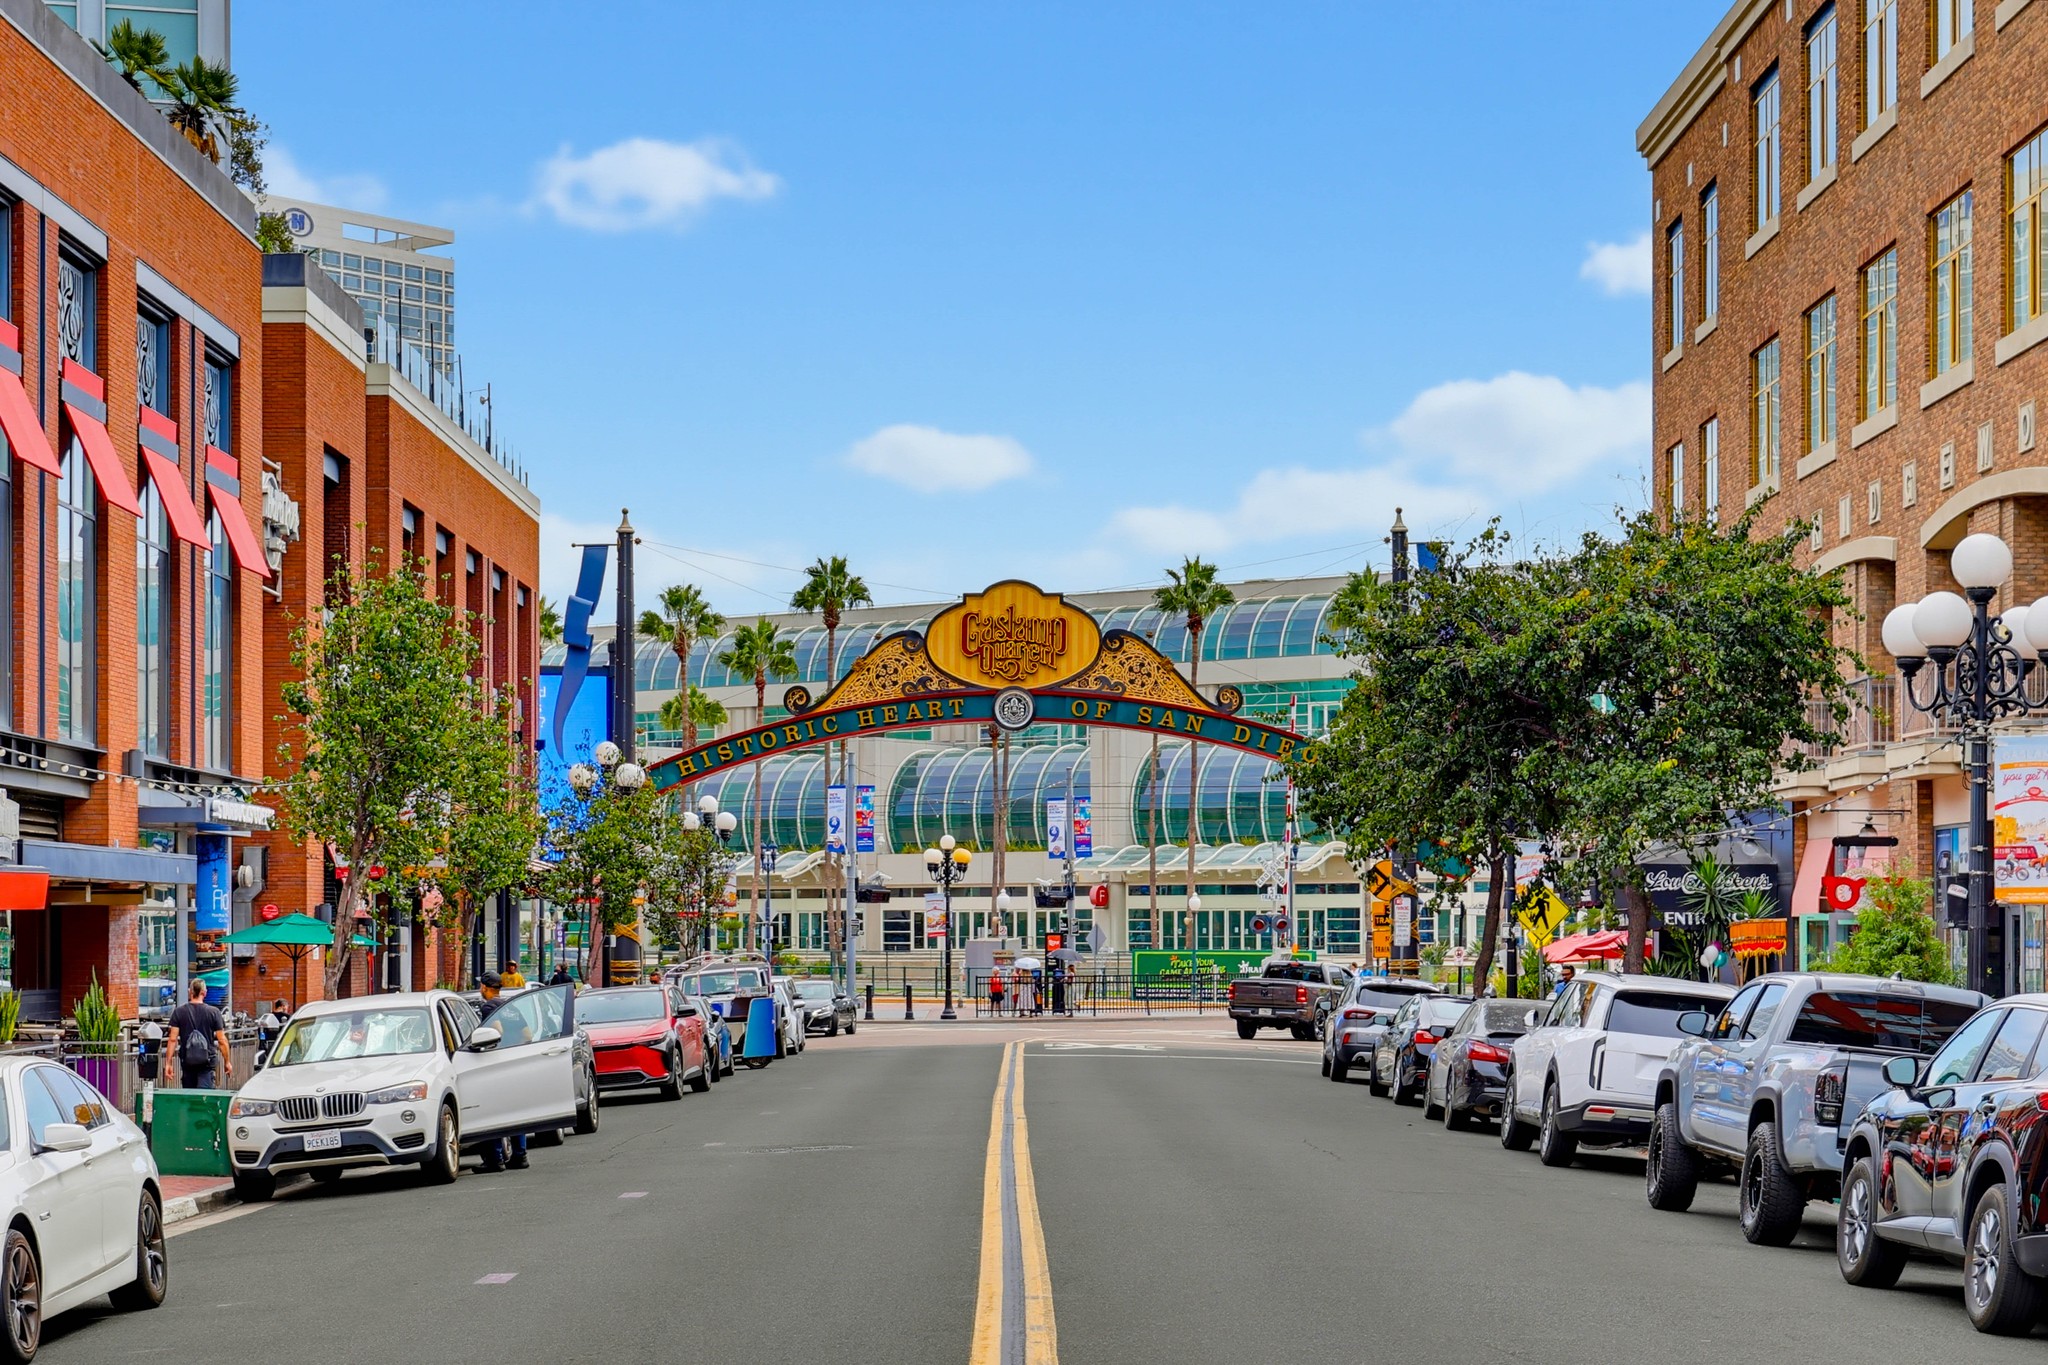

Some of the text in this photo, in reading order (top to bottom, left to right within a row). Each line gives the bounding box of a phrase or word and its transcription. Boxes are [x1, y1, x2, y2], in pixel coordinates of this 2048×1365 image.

[960, 604, 1067, 657] Gaslamp
[979, 640, 1057, 680] Quarter
[676, 699, 1319, 777] HISTORIC HEART OF SAN DIEG
[1644, 870, 1682, 893] Lou
[306, 1136, 339, 1149] 9CEK185
